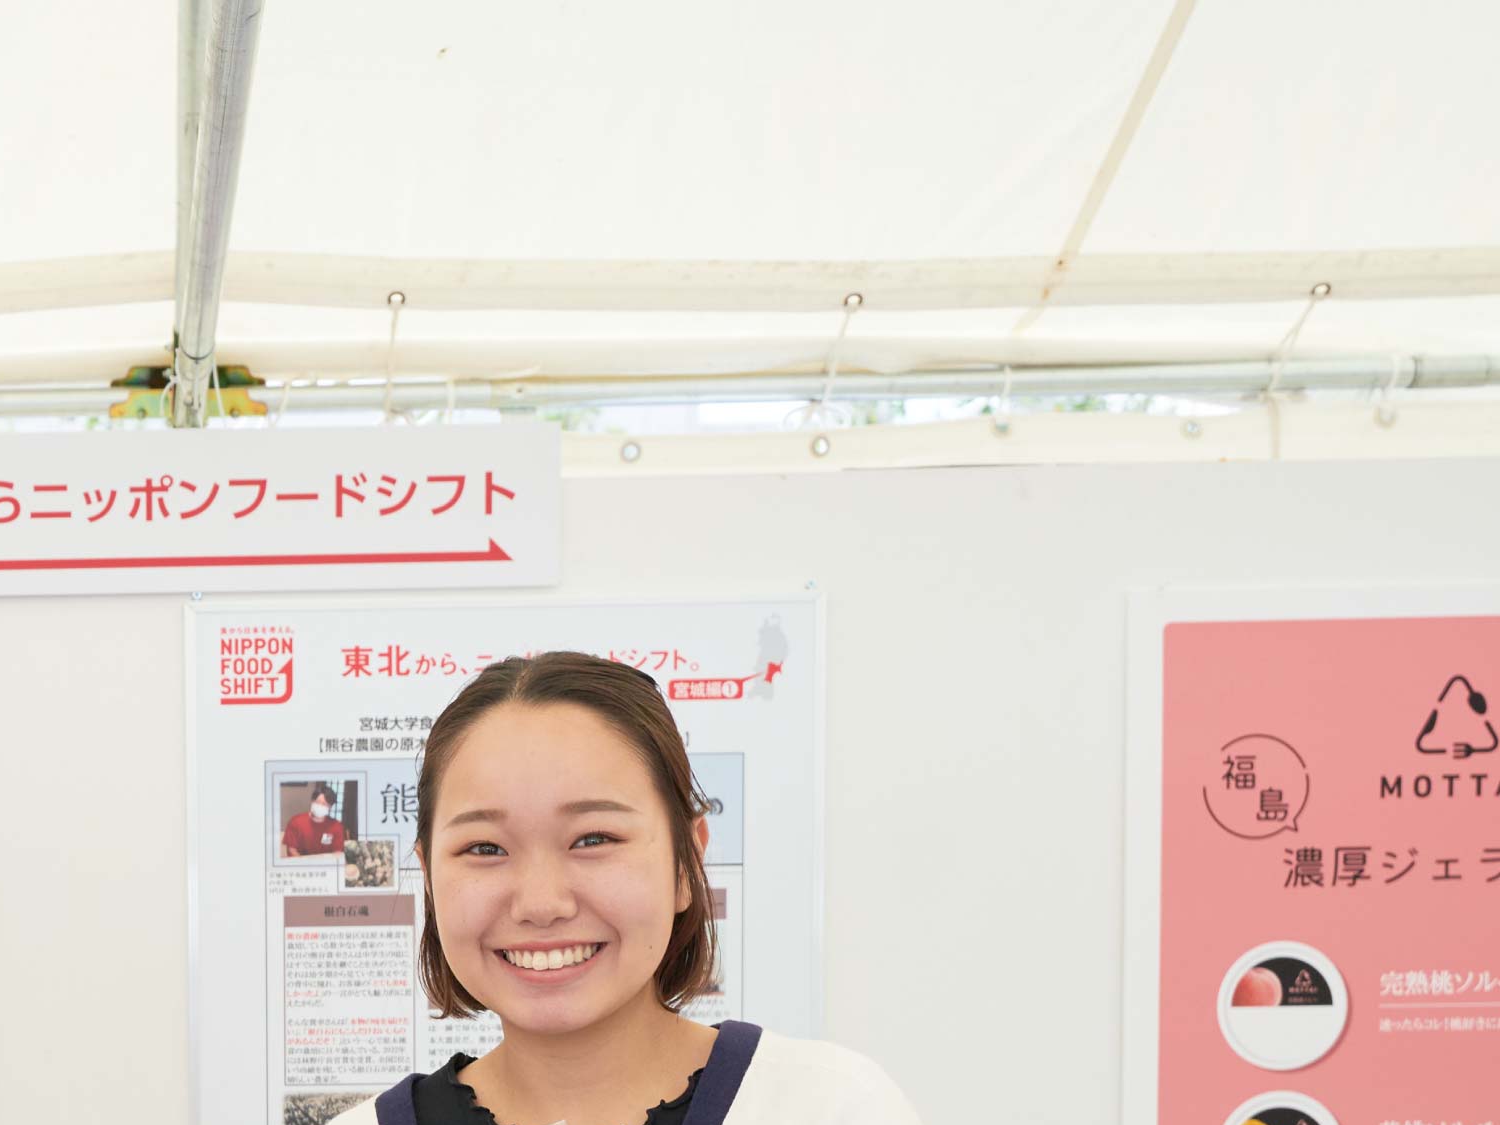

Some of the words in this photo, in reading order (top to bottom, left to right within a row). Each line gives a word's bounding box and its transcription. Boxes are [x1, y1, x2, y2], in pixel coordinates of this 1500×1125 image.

[220, 637, 293, 655] NIPPON
[220, 657, 273, 675] FOOD
[220, 677, 279, 695] SHIFT
[359, 717, 433, 731] 宮城大学食
[1222, 754, 1290, 822] 福島
[1380, 774, 1500, 799] MOTT
[380, 783, 419, 823] 熊
